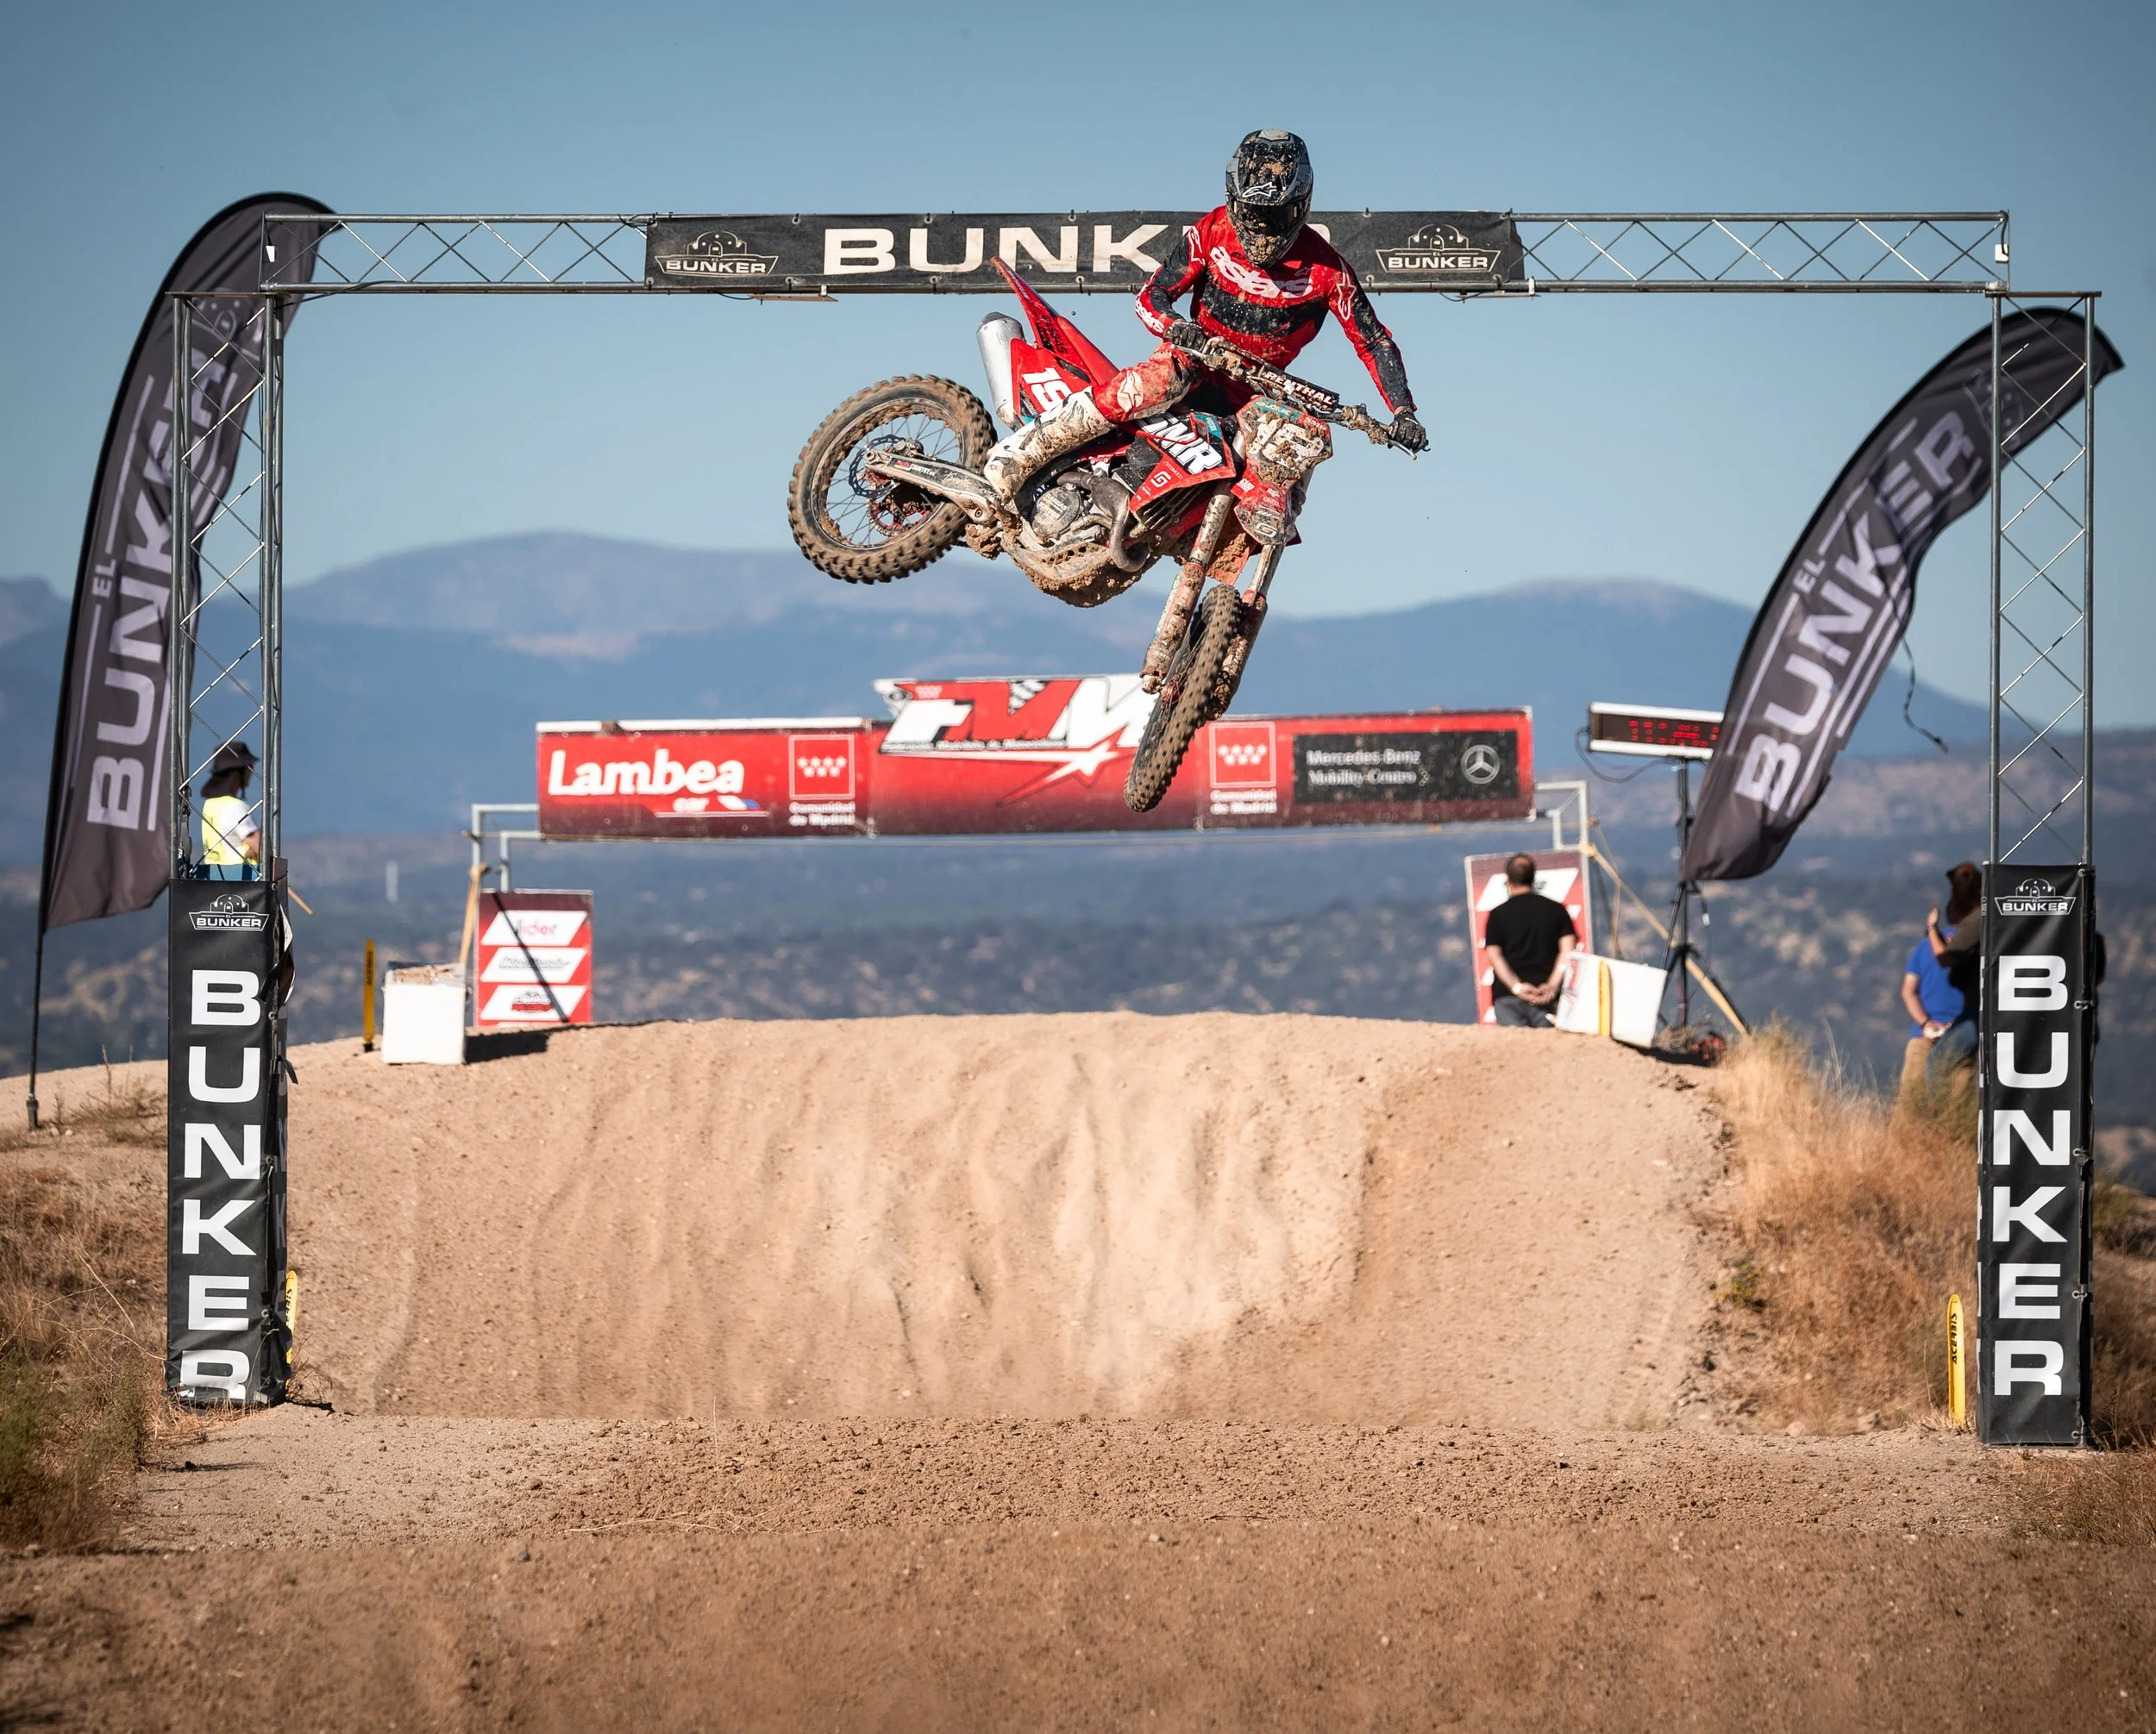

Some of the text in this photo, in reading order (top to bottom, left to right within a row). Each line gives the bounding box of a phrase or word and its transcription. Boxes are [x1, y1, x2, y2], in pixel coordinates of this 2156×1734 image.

[666, 260, 767, 273] BUNKER
[823, 224, 1331, 276] BUNK
[1388, 256, 1488, 268] BUNKER
[1265, 371, 1334, 405] RENTHAL
[91, 559, 116, 598] EL
[1793, 559, 1827, 594] EL
[1734, 410, 1975, 812] BUNKER
[548, 748, 745, 796] Lambea
[197, 917, 261, 927] BUNKER
[2002, 902, 2068, 911] BUNKER
[181, 969, 261, 1400] BUNKER
[1993, 955, 2071, 1396] BUNKER
